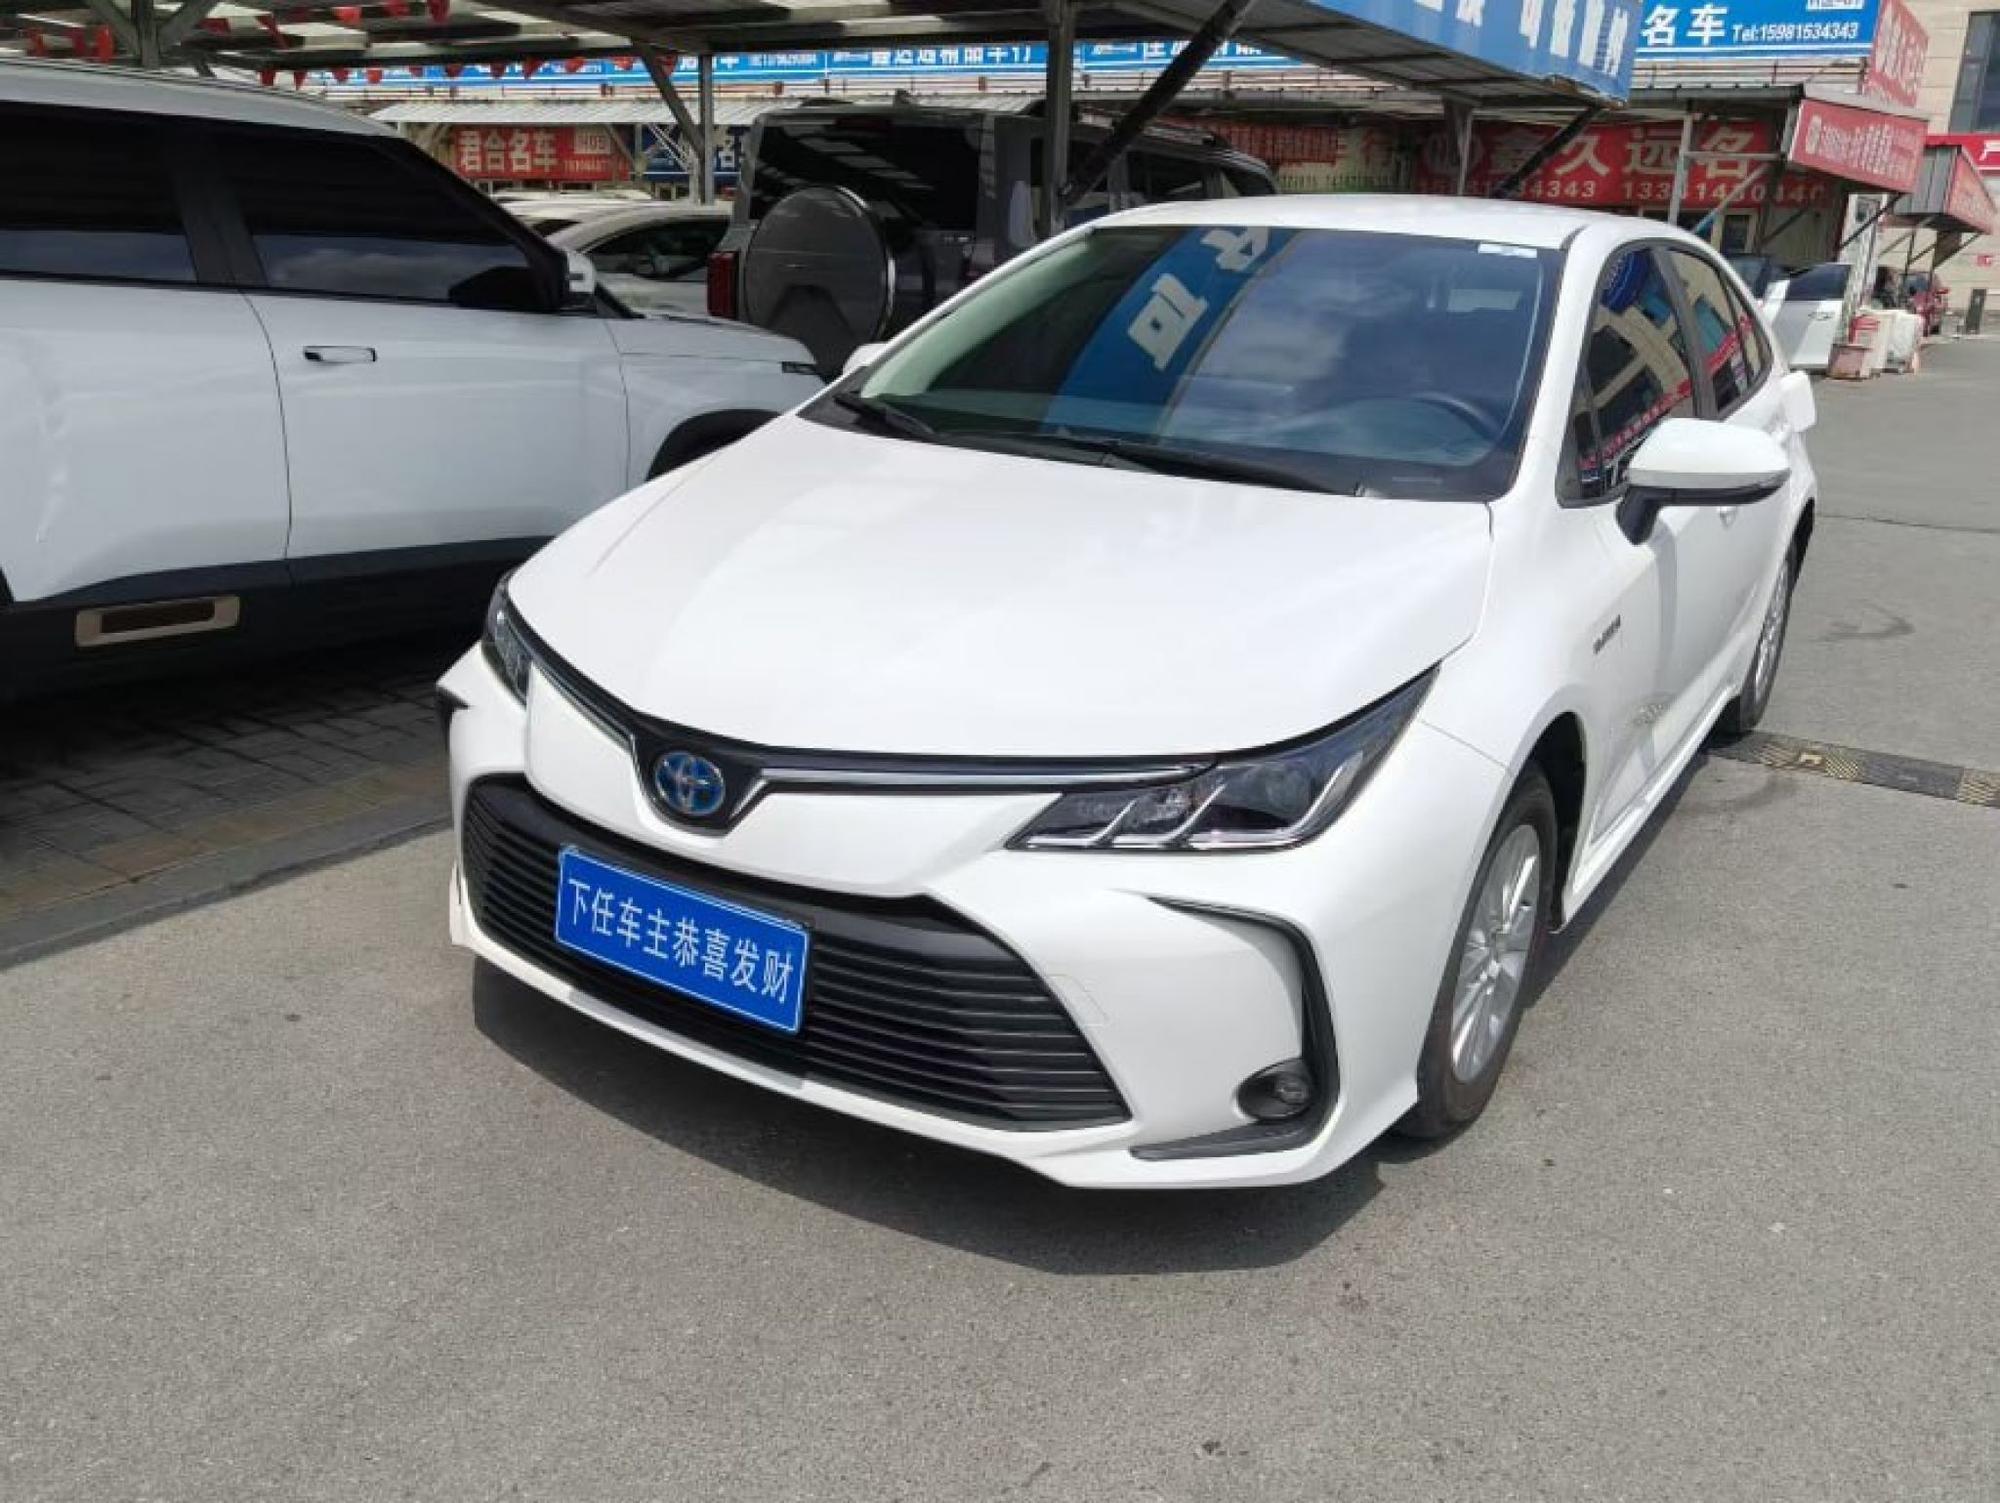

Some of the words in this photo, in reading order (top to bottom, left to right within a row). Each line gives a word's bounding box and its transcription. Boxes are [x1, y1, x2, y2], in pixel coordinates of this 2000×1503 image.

[1641, 4, 1728, 46] 名车
[568, 876, 794, 1004] 下任车主恭喜发财
